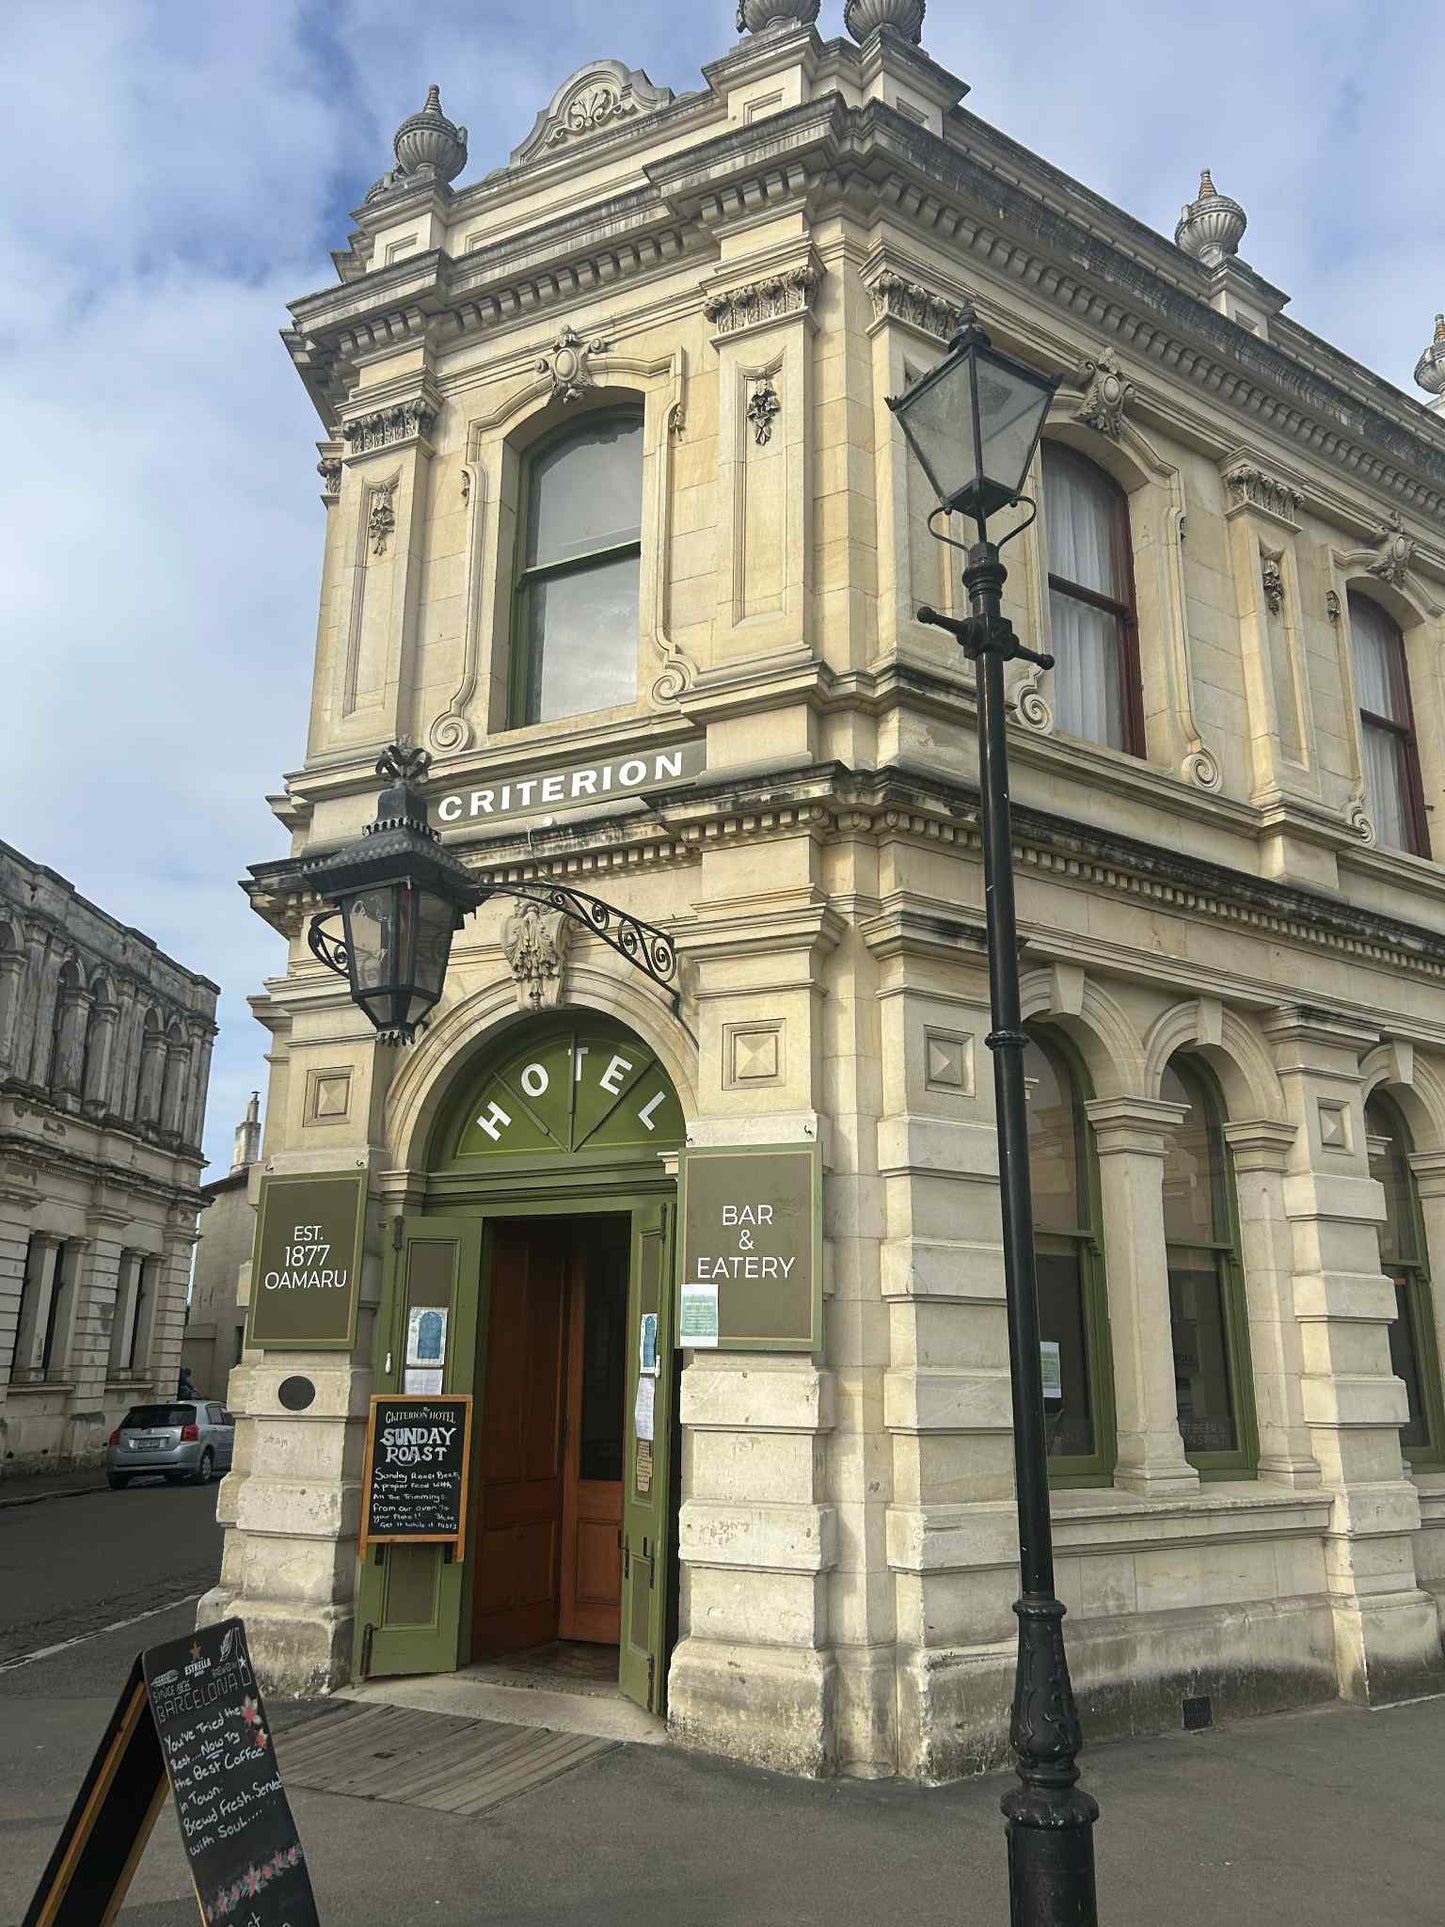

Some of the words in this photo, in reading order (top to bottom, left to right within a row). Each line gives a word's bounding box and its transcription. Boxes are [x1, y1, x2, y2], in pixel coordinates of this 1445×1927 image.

[438, 751, 682, 821] CRITERION
[476, 1047, 666, 1141] HOTEL
[722, 1204, 773, 1226] BAR
[294, 1225, 323, 1241] EST.
[739, 1229, 754, 1250] &
[285, 1244, 330, 1267] 1877
[697, 1256, 796, 1279] EATERY
[264, 1269, 347, 1289] OAMARU
[385, 1410, 428, 1424] CRITERION
[429, 1411, 457, 1424] HOTEL
[380, 1427, 457, 1446] SUNDAY
[385, 1446, 447, 1467] ROAST
[375, 1467, 408, 1483] Sunday
[184, 1658, 212, 1676] ESTRELLA
[156, 1673, 239, 1724] BARCELONA
[164, 1730, 196, 1754] You've
[196, 1711, 224, 1734] Tried
[225, 1706, 242, 1719] the
[224, 1731, 241, 1744] Try
[174, 1778, 193, 1792] the
[193, 1758, 221, 1780] Best
[180, 1803, 189, 1814] in
[189, 1836, 215, 1856] with
